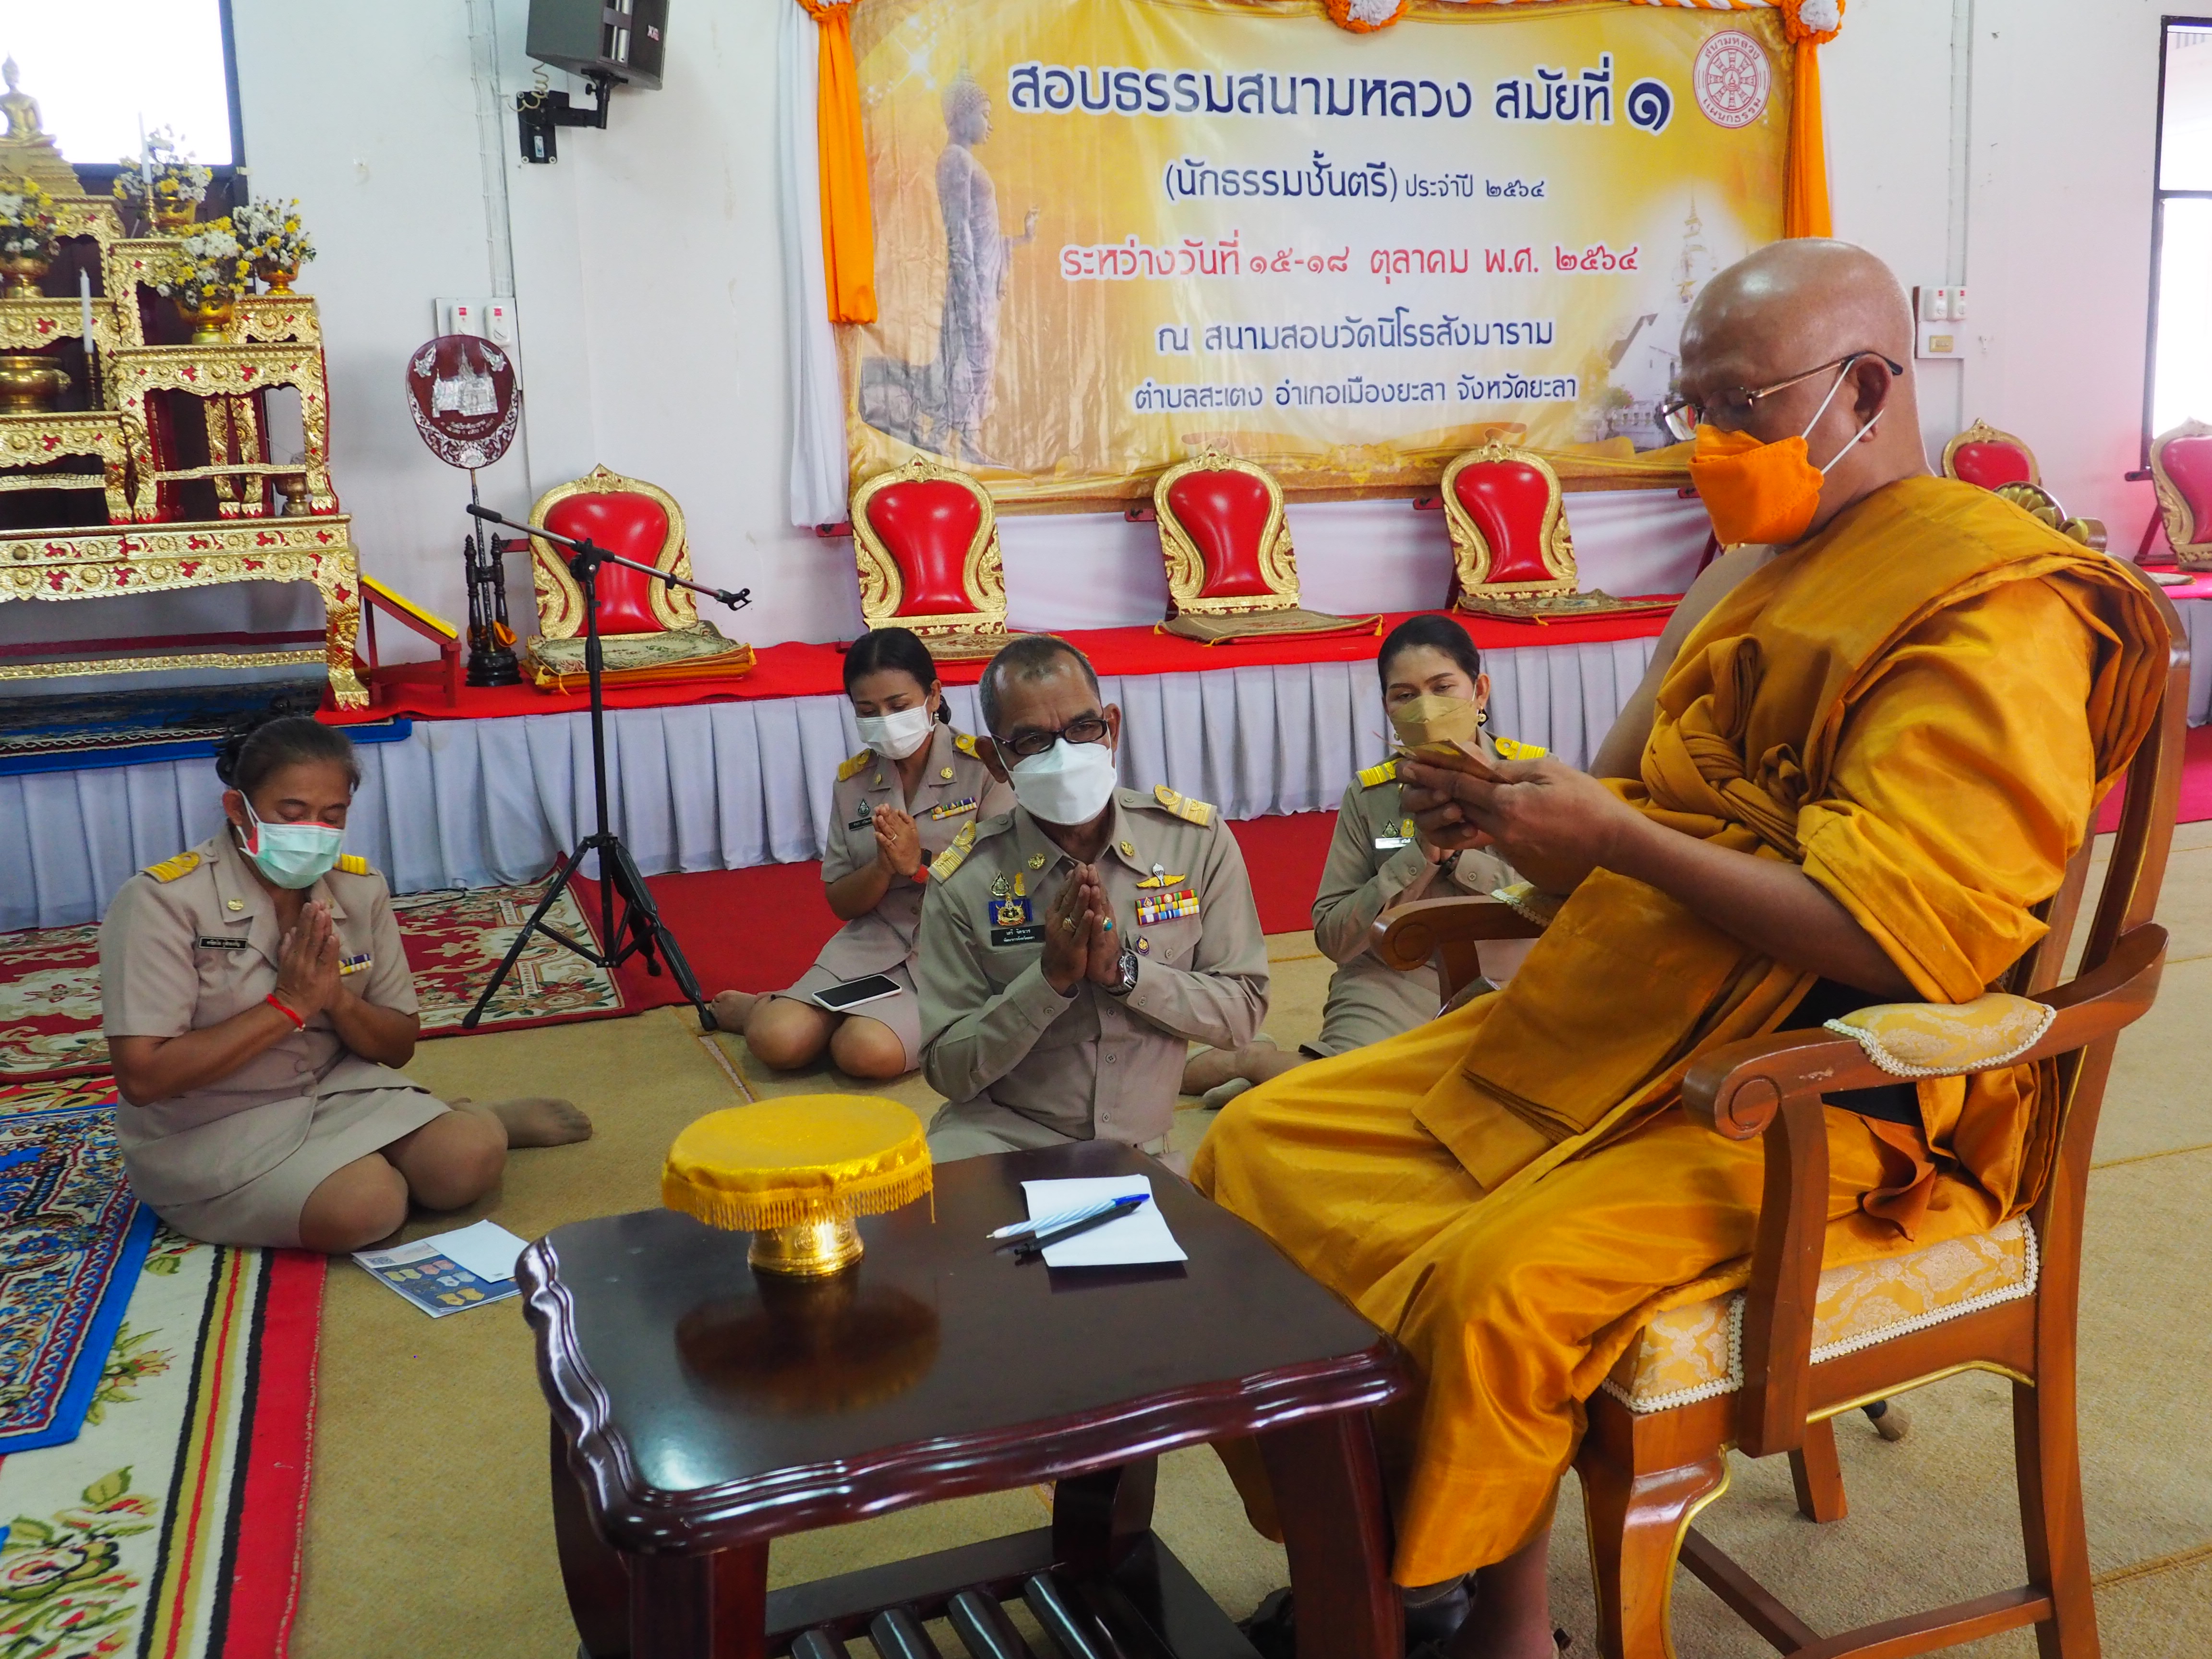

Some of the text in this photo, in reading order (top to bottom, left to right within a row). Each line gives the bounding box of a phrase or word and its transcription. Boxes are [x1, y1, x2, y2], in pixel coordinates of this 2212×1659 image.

[1011, 56, 1671, 131] สอบธรรมสนามหลวง สมัยที่ ๑
[1166, 150, 1545, 202] (นักธรรมชั้นตรี) ประจำปี ๒๕๖๔
[1063, 229, 1638, 285] ระหว่างวันที่ ๑๕-๑๘ ตุลาคม พ.ศ. ๒๕๖๔
[1158, 327, 1189, 351] ณ
[1135, 381, 1263, 409] ตำบลสะเตง
[1457, 373, 1576, 400] จังหวัดยะลา
